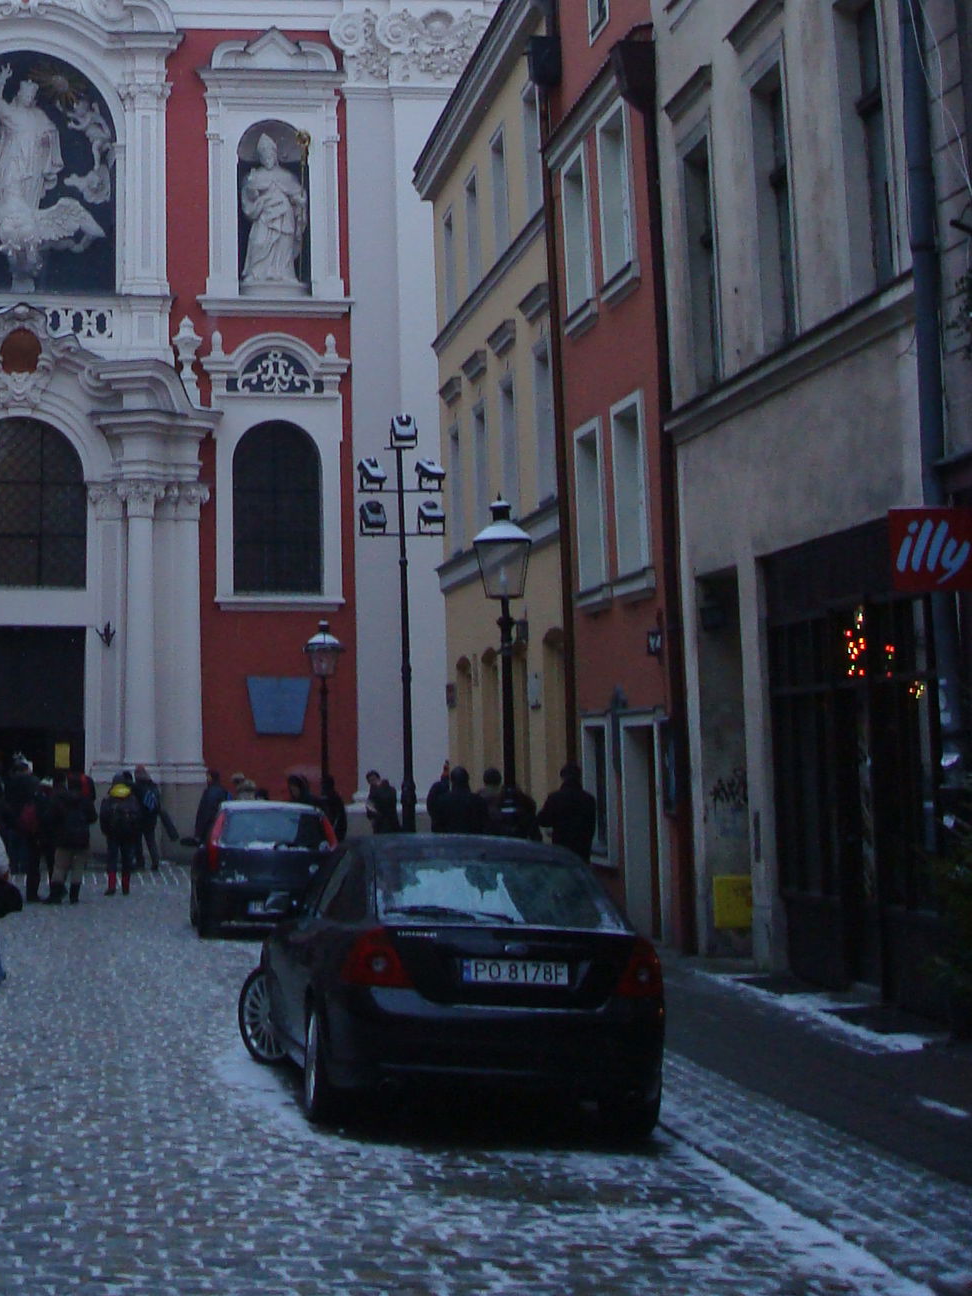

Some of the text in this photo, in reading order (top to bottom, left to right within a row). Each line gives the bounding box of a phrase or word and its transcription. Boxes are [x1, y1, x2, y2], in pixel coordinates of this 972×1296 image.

[895, 517, 971, 584] illy
[474, 961, 564, 982] PO 8178F
